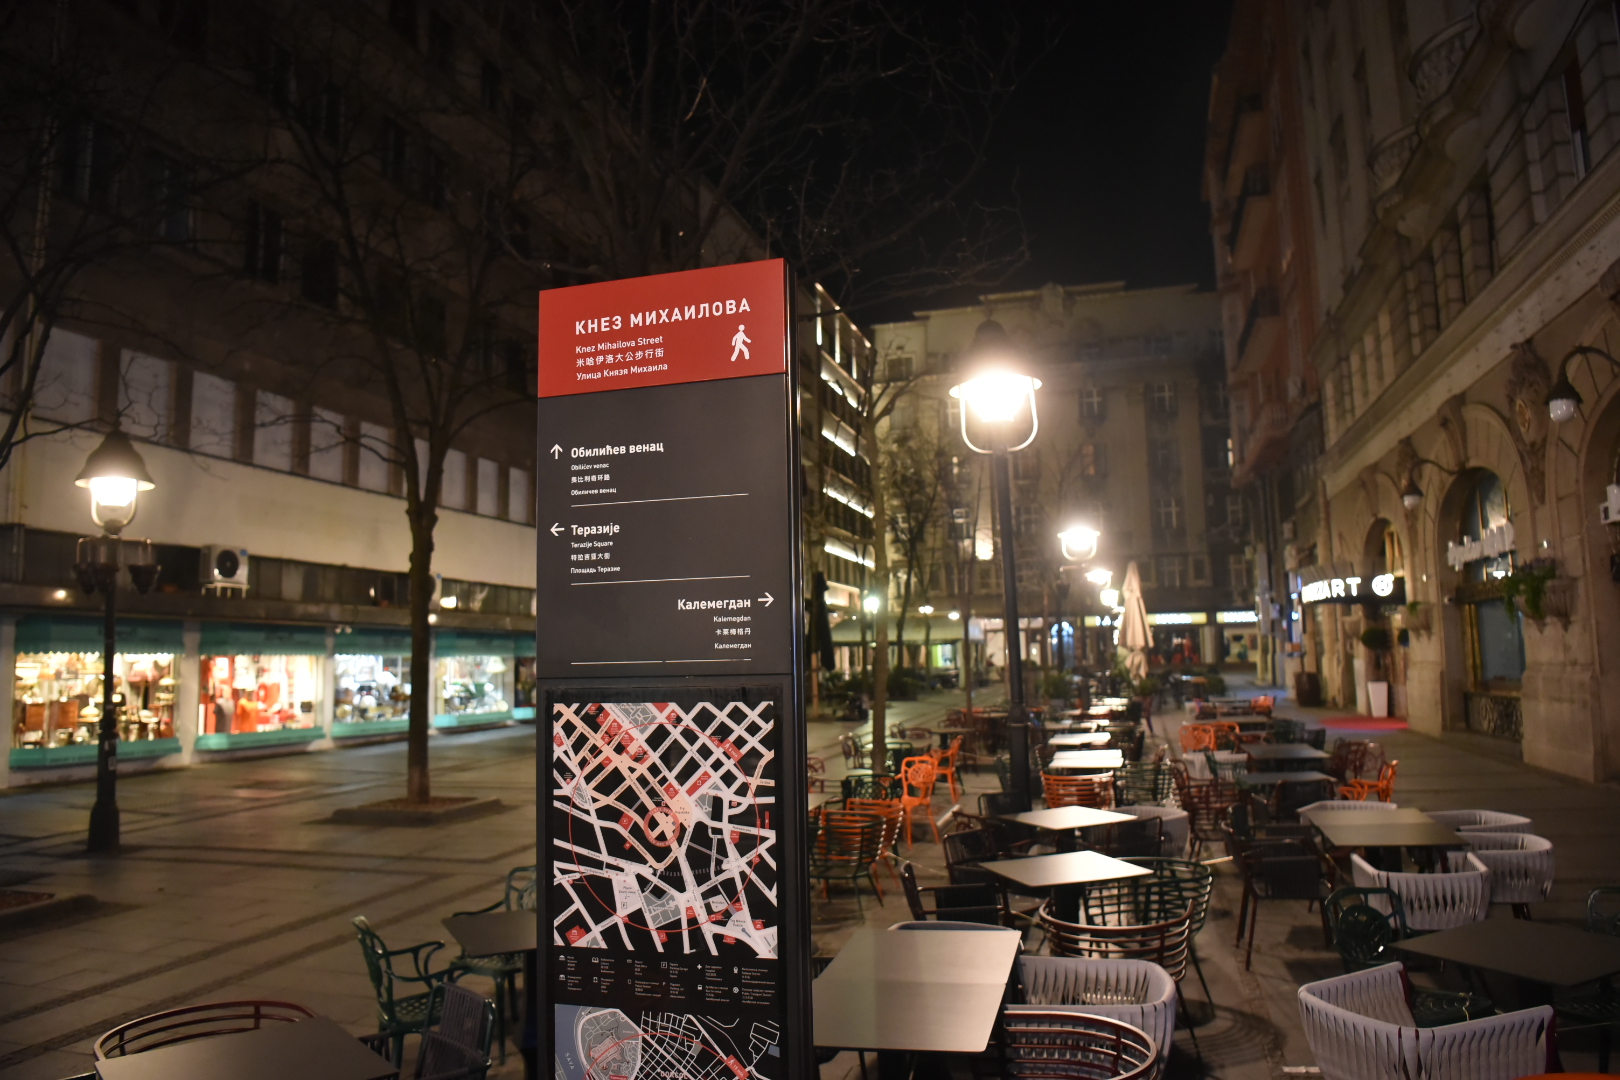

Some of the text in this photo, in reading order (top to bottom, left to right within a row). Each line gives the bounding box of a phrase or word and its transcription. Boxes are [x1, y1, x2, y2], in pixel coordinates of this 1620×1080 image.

[576, 298, 750, 335] КНЕЗ МИХАИЛОВА
[576, 336, 663, 354] Knez Mihailova Street
[576, 348, 664, 368] 米哈伊洛大公步行街
[576, 363, 668, 381] Улица Князя Михаила
[571, 442, 664, 458] Обилићев венац
[571, 523, 620, 537] Теразије
[1301, 576, 1362, 603] ZART
[678, 598, 751, 610] Калемегдан
